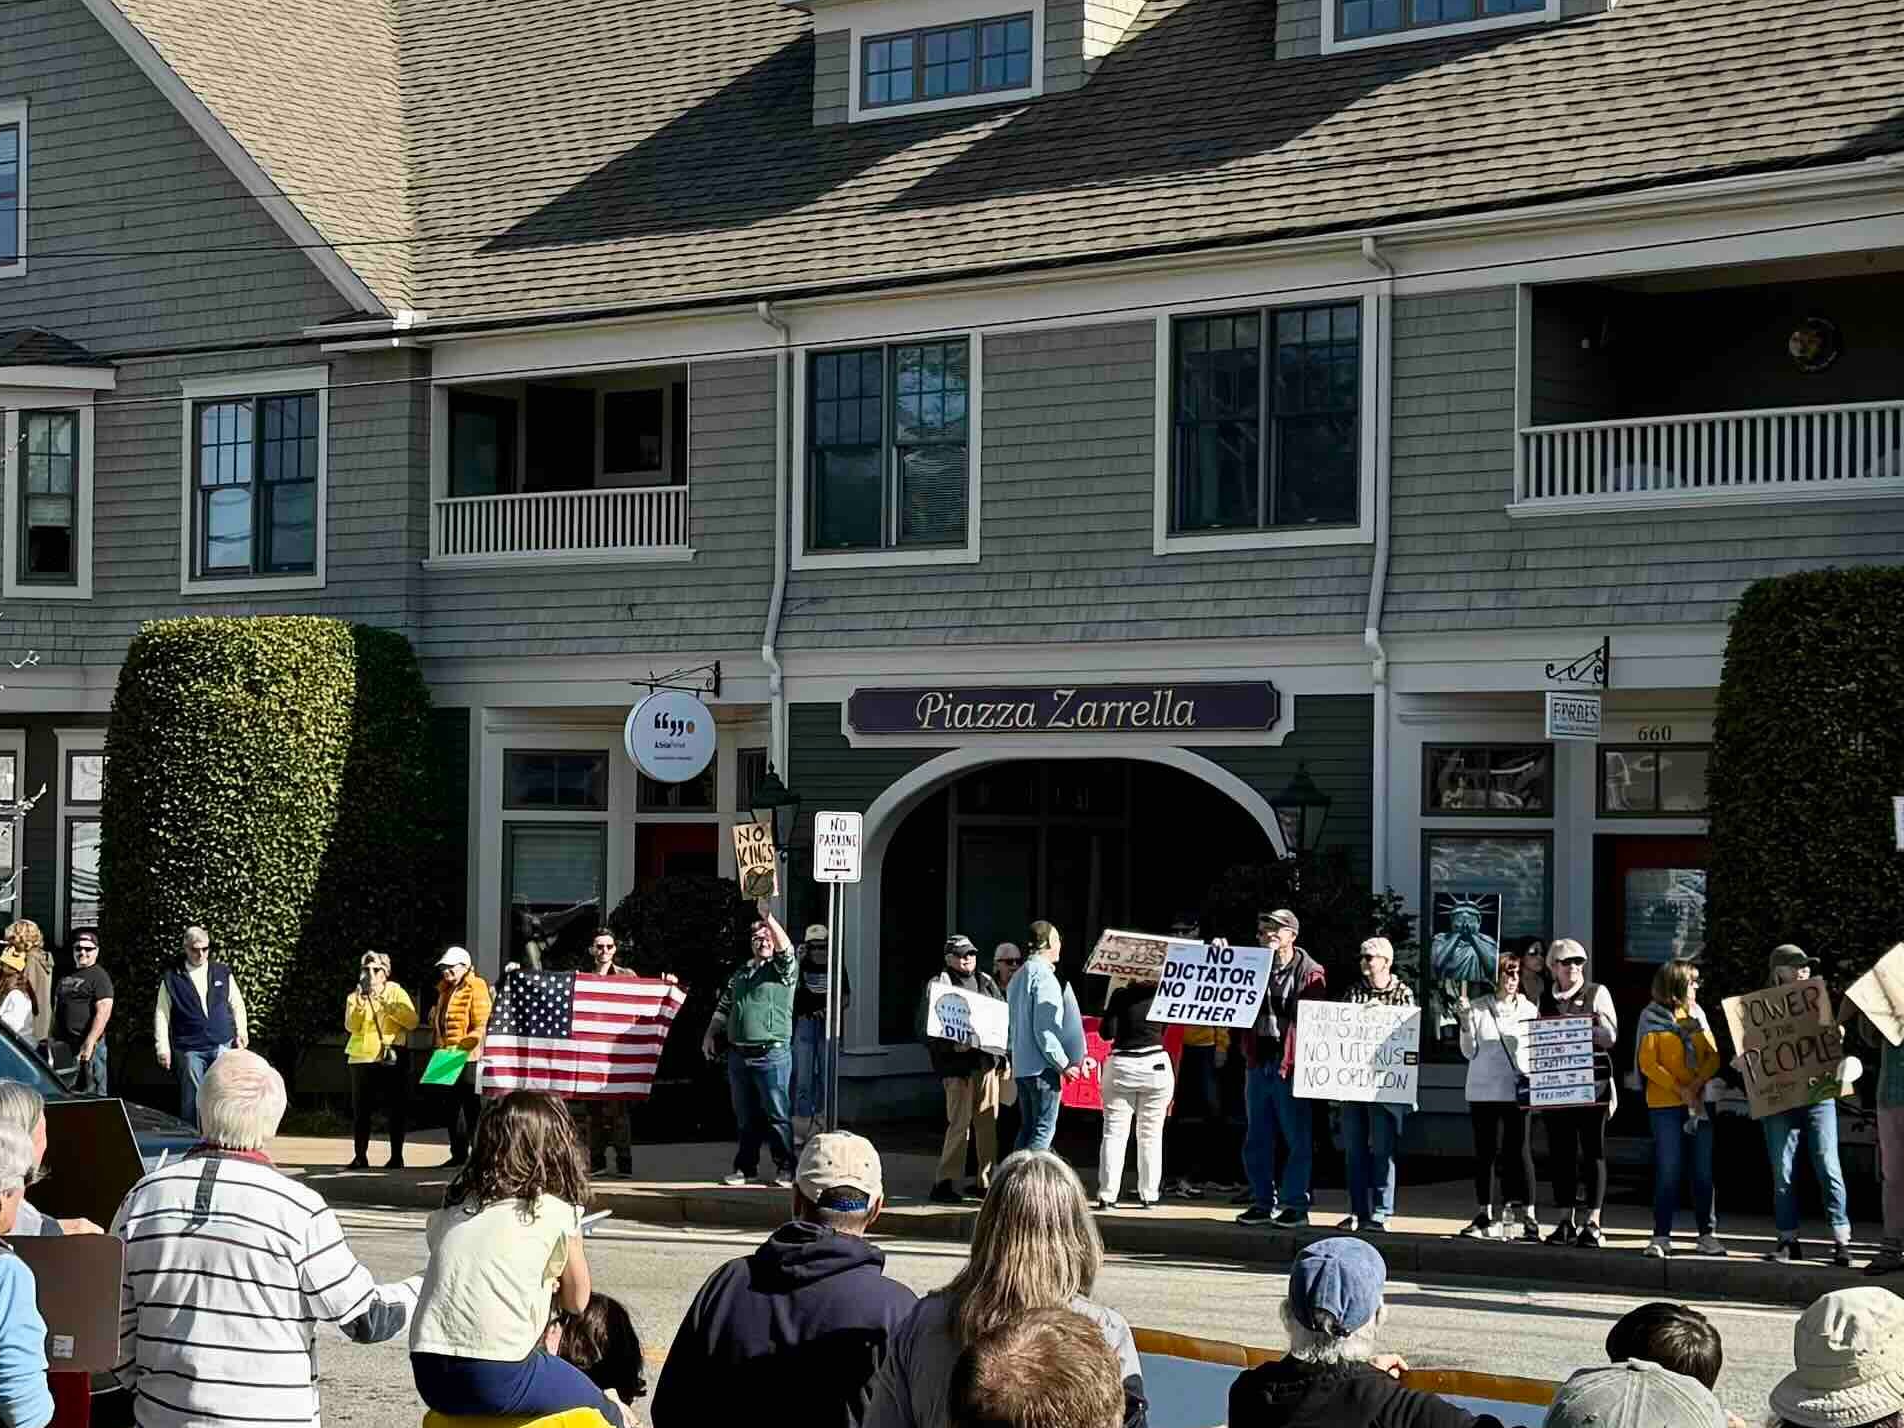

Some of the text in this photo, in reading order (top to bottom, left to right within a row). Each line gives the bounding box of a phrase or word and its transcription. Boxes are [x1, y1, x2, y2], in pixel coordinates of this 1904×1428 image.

[915, 689, 1196, 730] Piazza Zarrella
[1638, 724, 1672, 741] 660
[738, 826, 765, 844] NO
[831, 818, 847, 831] NO
[818, 834, 857, 847] PARKING
[737, 844, 774, 868] KINGS
[1206, 946, 1235, 965] NO
[1163, 961, 1257, 986] DICTATOR
[1157, 980, 1258, 1006] NO IDIOTS
[1167, 1003, 1236, 1023] EITHER
[1737, 986, 1821, 1027] POWER
[1304, 1041, 1405, 1066] NO UTERUS
[1743, 1032, 1840, 1084] PEOPLE
[1303, 1066, 1409, 1089] NO OPINION
